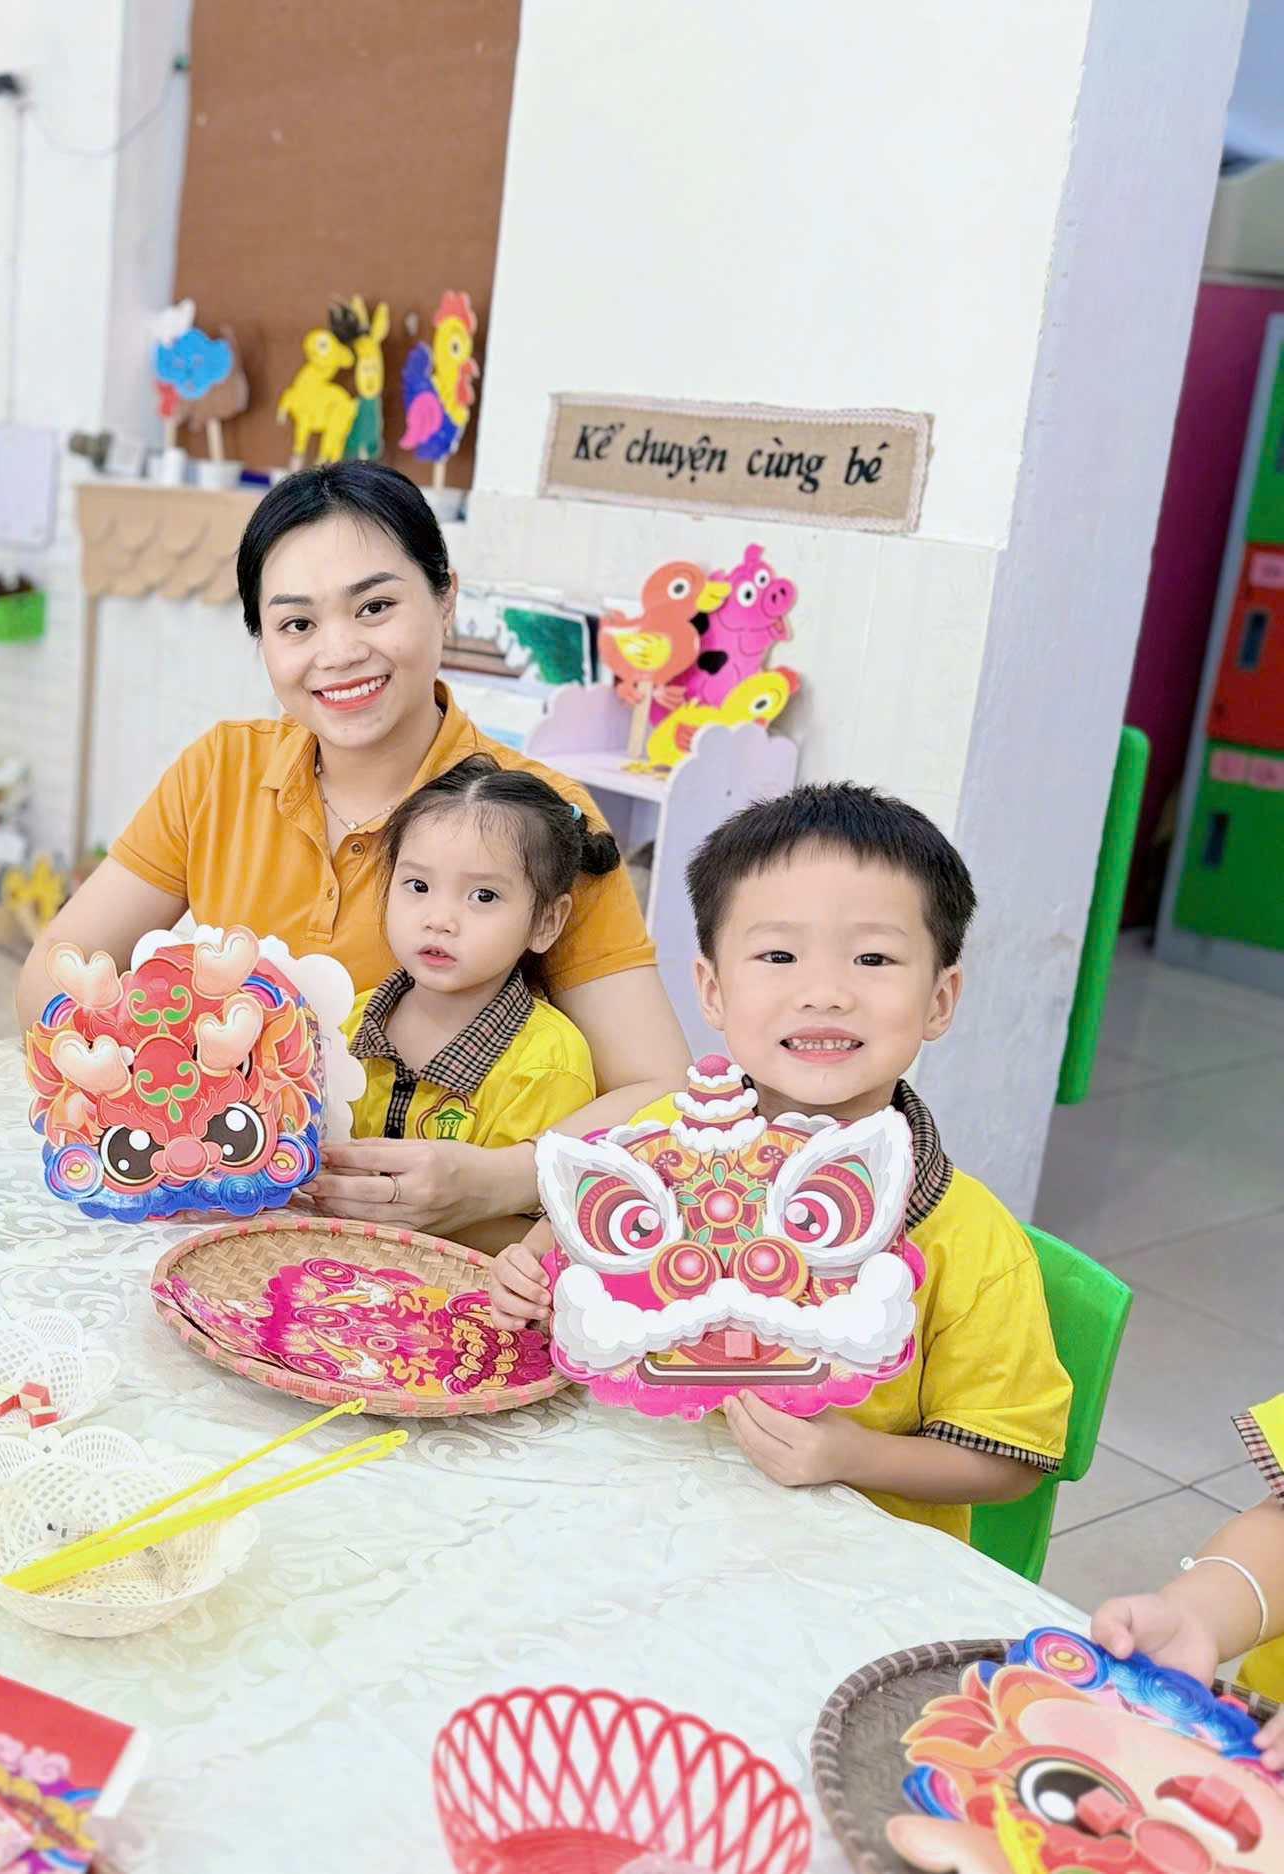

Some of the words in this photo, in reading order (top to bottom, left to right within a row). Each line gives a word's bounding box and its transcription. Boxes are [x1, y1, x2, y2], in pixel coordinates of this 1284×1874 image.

[573, 423, 626, 462] Kể
[625, 428, 728, 483] chuyện
[747, 437, 828, 494] cùng
[844, 442, 892, 486] bé
